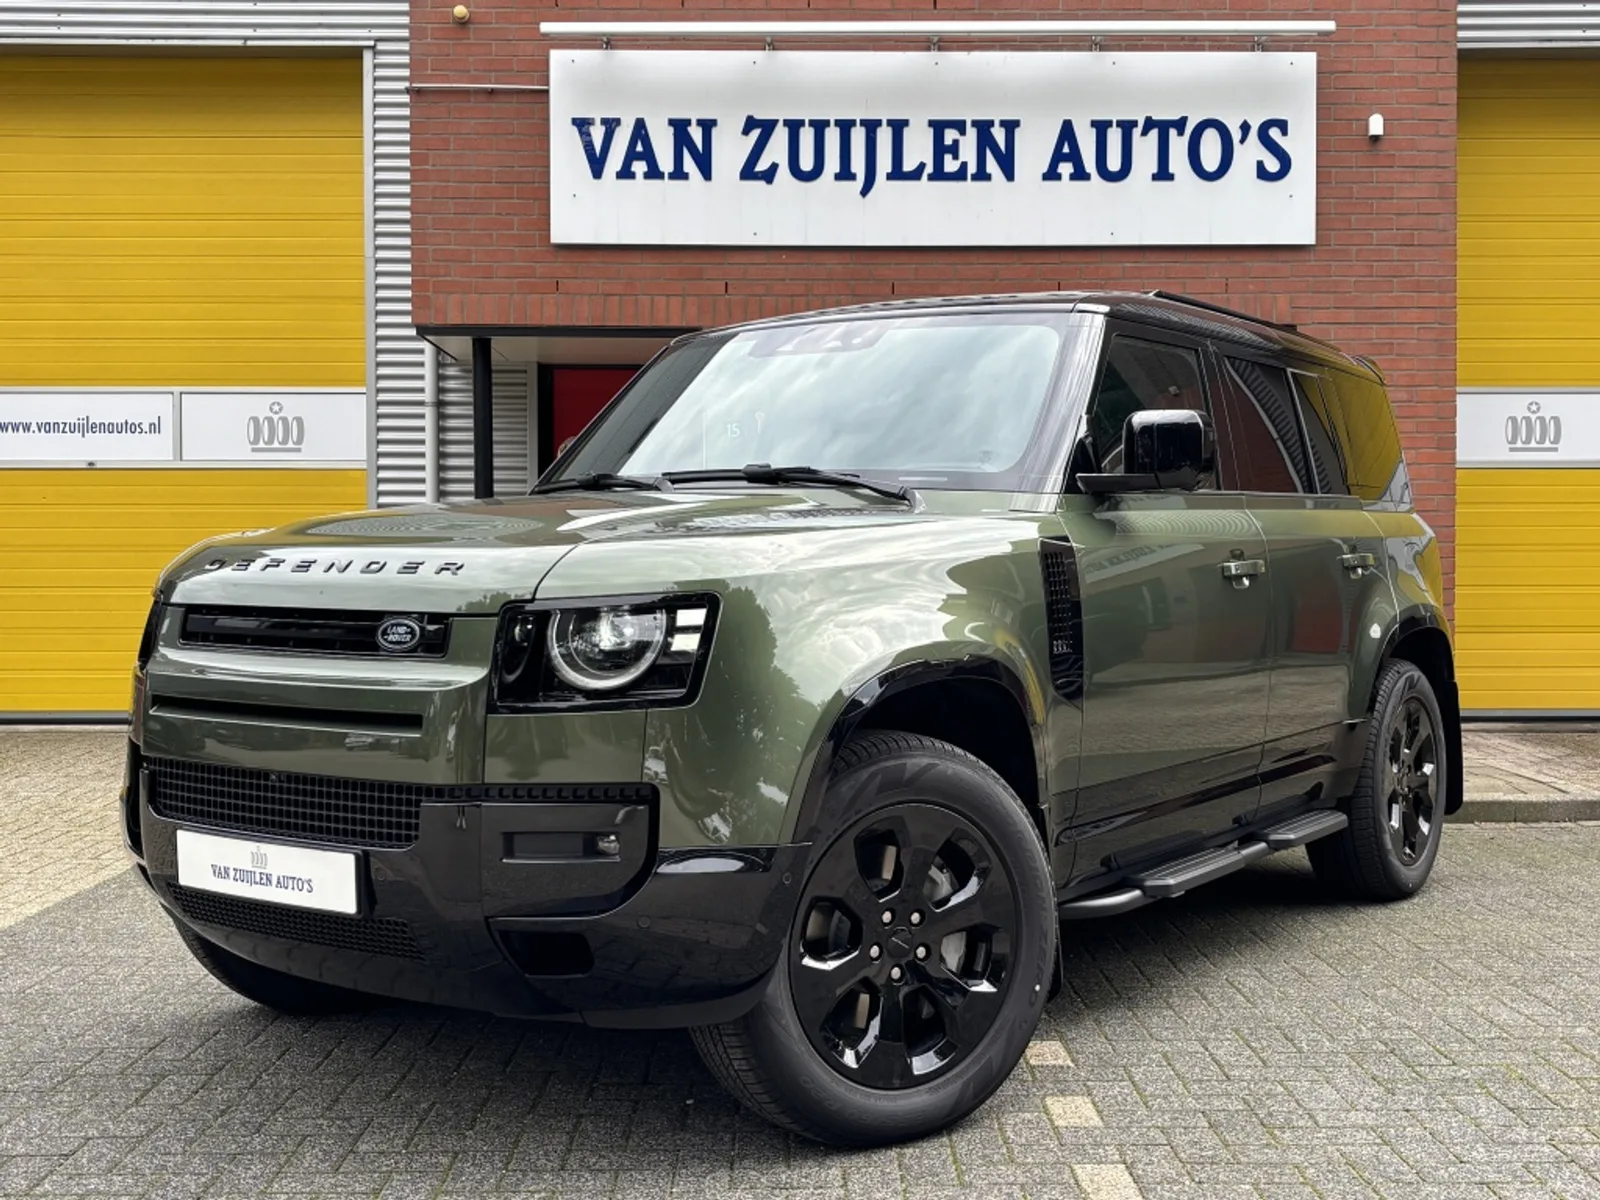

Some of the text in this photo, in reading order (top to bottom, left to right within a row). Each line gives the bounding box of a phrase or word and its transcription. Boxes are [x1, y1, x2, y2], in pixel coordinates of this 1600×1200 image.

[571, 115, 1293, 198] VAN ZUIJLEN AUTO'S
[0, 415, 161, 438] www.vanzuijlenautos.nl
[204, 558, 465, 575] DEFENDER
[211, 863, 314, 893] VAN ZUIJLEN AUTO'S
